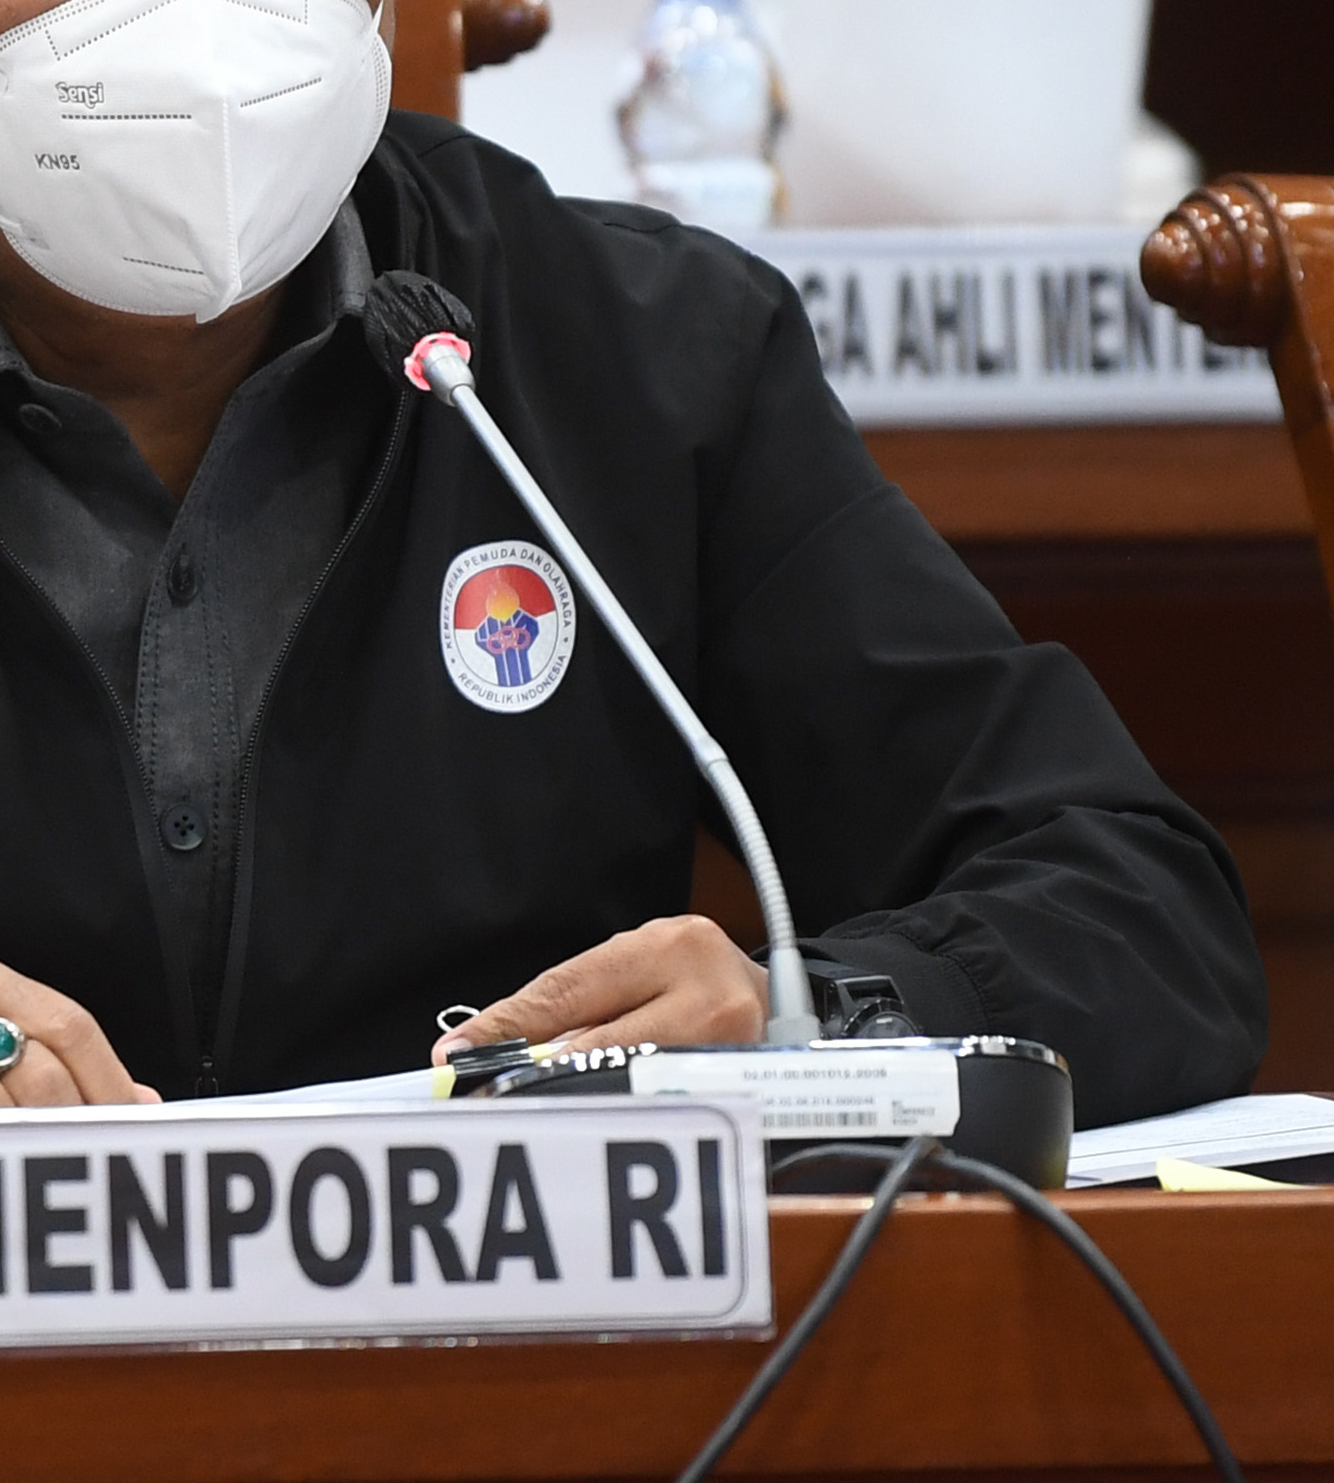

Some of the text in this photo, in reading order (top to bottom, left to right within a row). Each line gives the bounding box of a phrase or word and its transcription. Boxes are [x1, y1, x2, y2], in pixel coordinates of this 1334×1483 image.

[55, 81, 105, 109] Sensi
[35, 153, 81, 171] KN95
[893, 269, 1016, 378] AHLI
[443, 548, 572, 649] KEMENTERIAN PEMUDA DAN OLAHRAGA
[458, 654, 566, 704] REPUBLIK INDONESIA
[605, 1137, 728, 1281] RI
